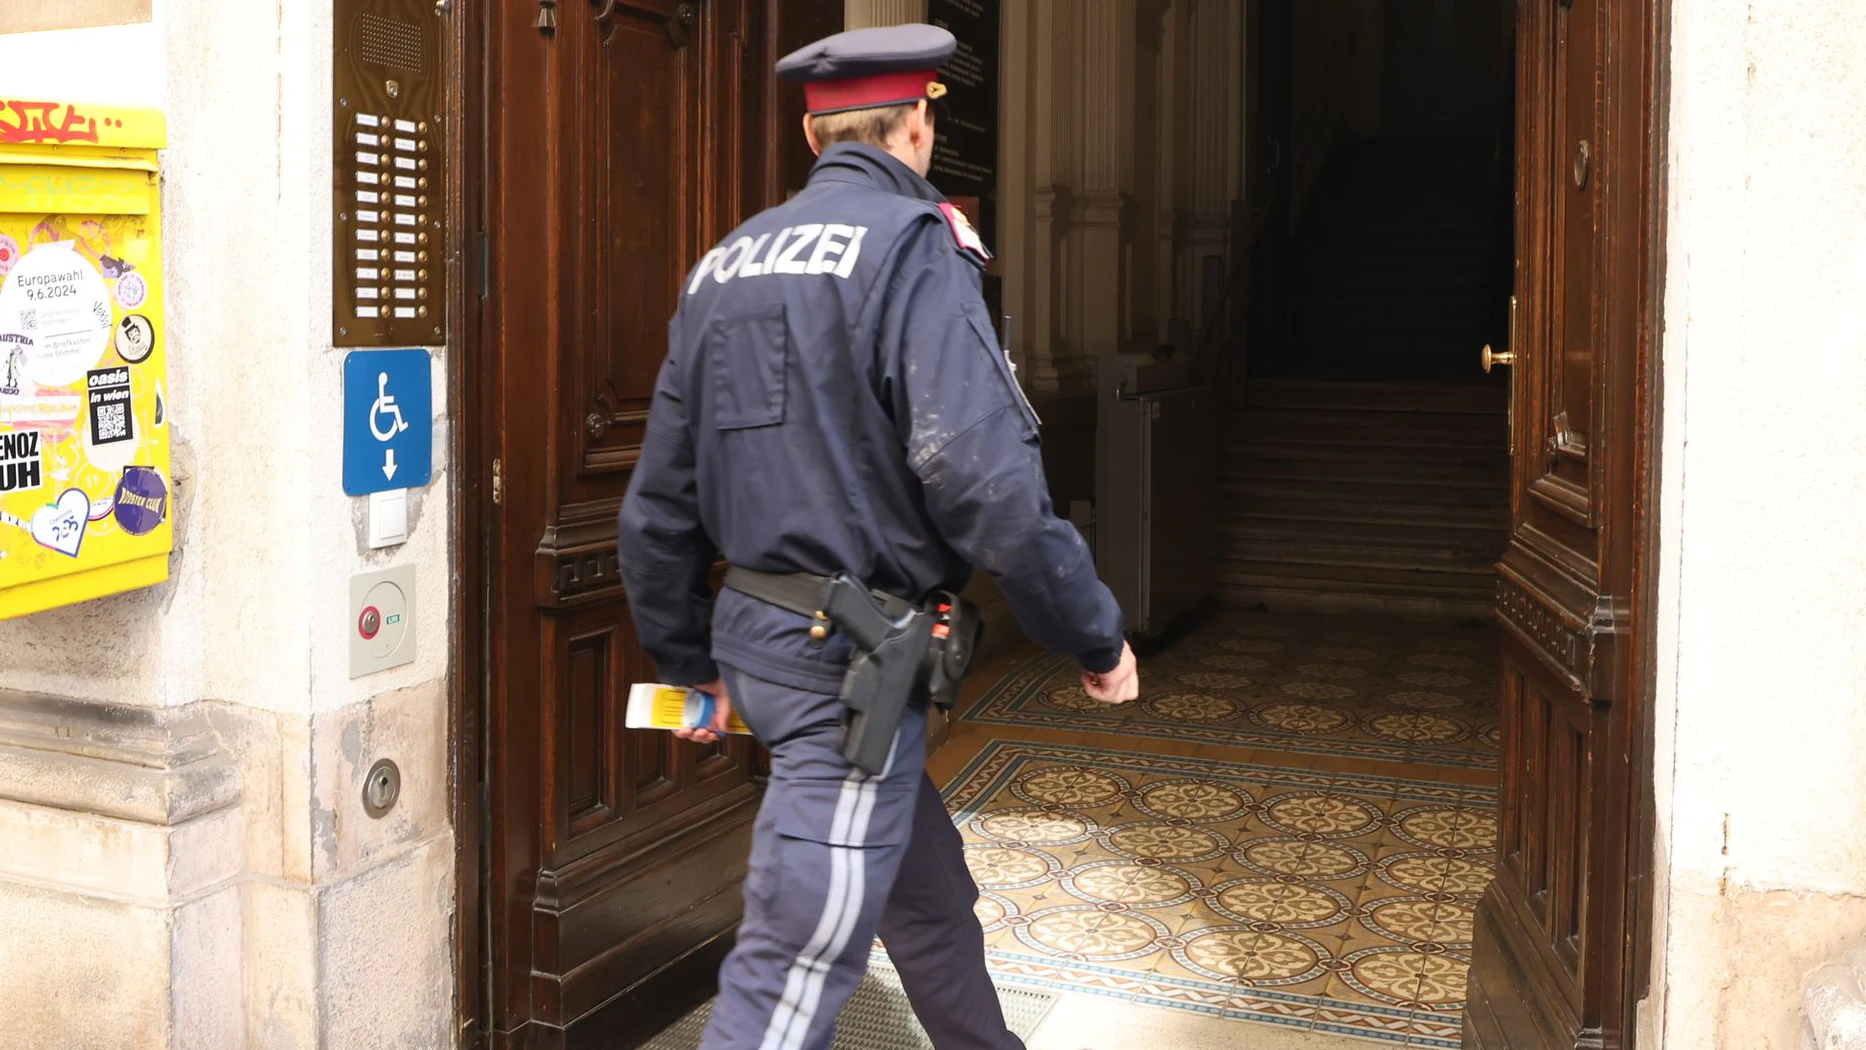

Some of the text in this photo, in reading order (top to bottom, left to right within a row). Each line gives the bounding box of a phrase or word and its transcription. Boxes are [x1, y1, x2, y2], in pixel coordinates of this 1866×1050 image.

[687, 223, 869, 295] POLIZEI
[17, 269, 84, 287] Europawahl
[26, 284, 77, 301] 9.6.2024
[89, 369, 128, 386] oasis
[90, 389, 129, 404] in wien
